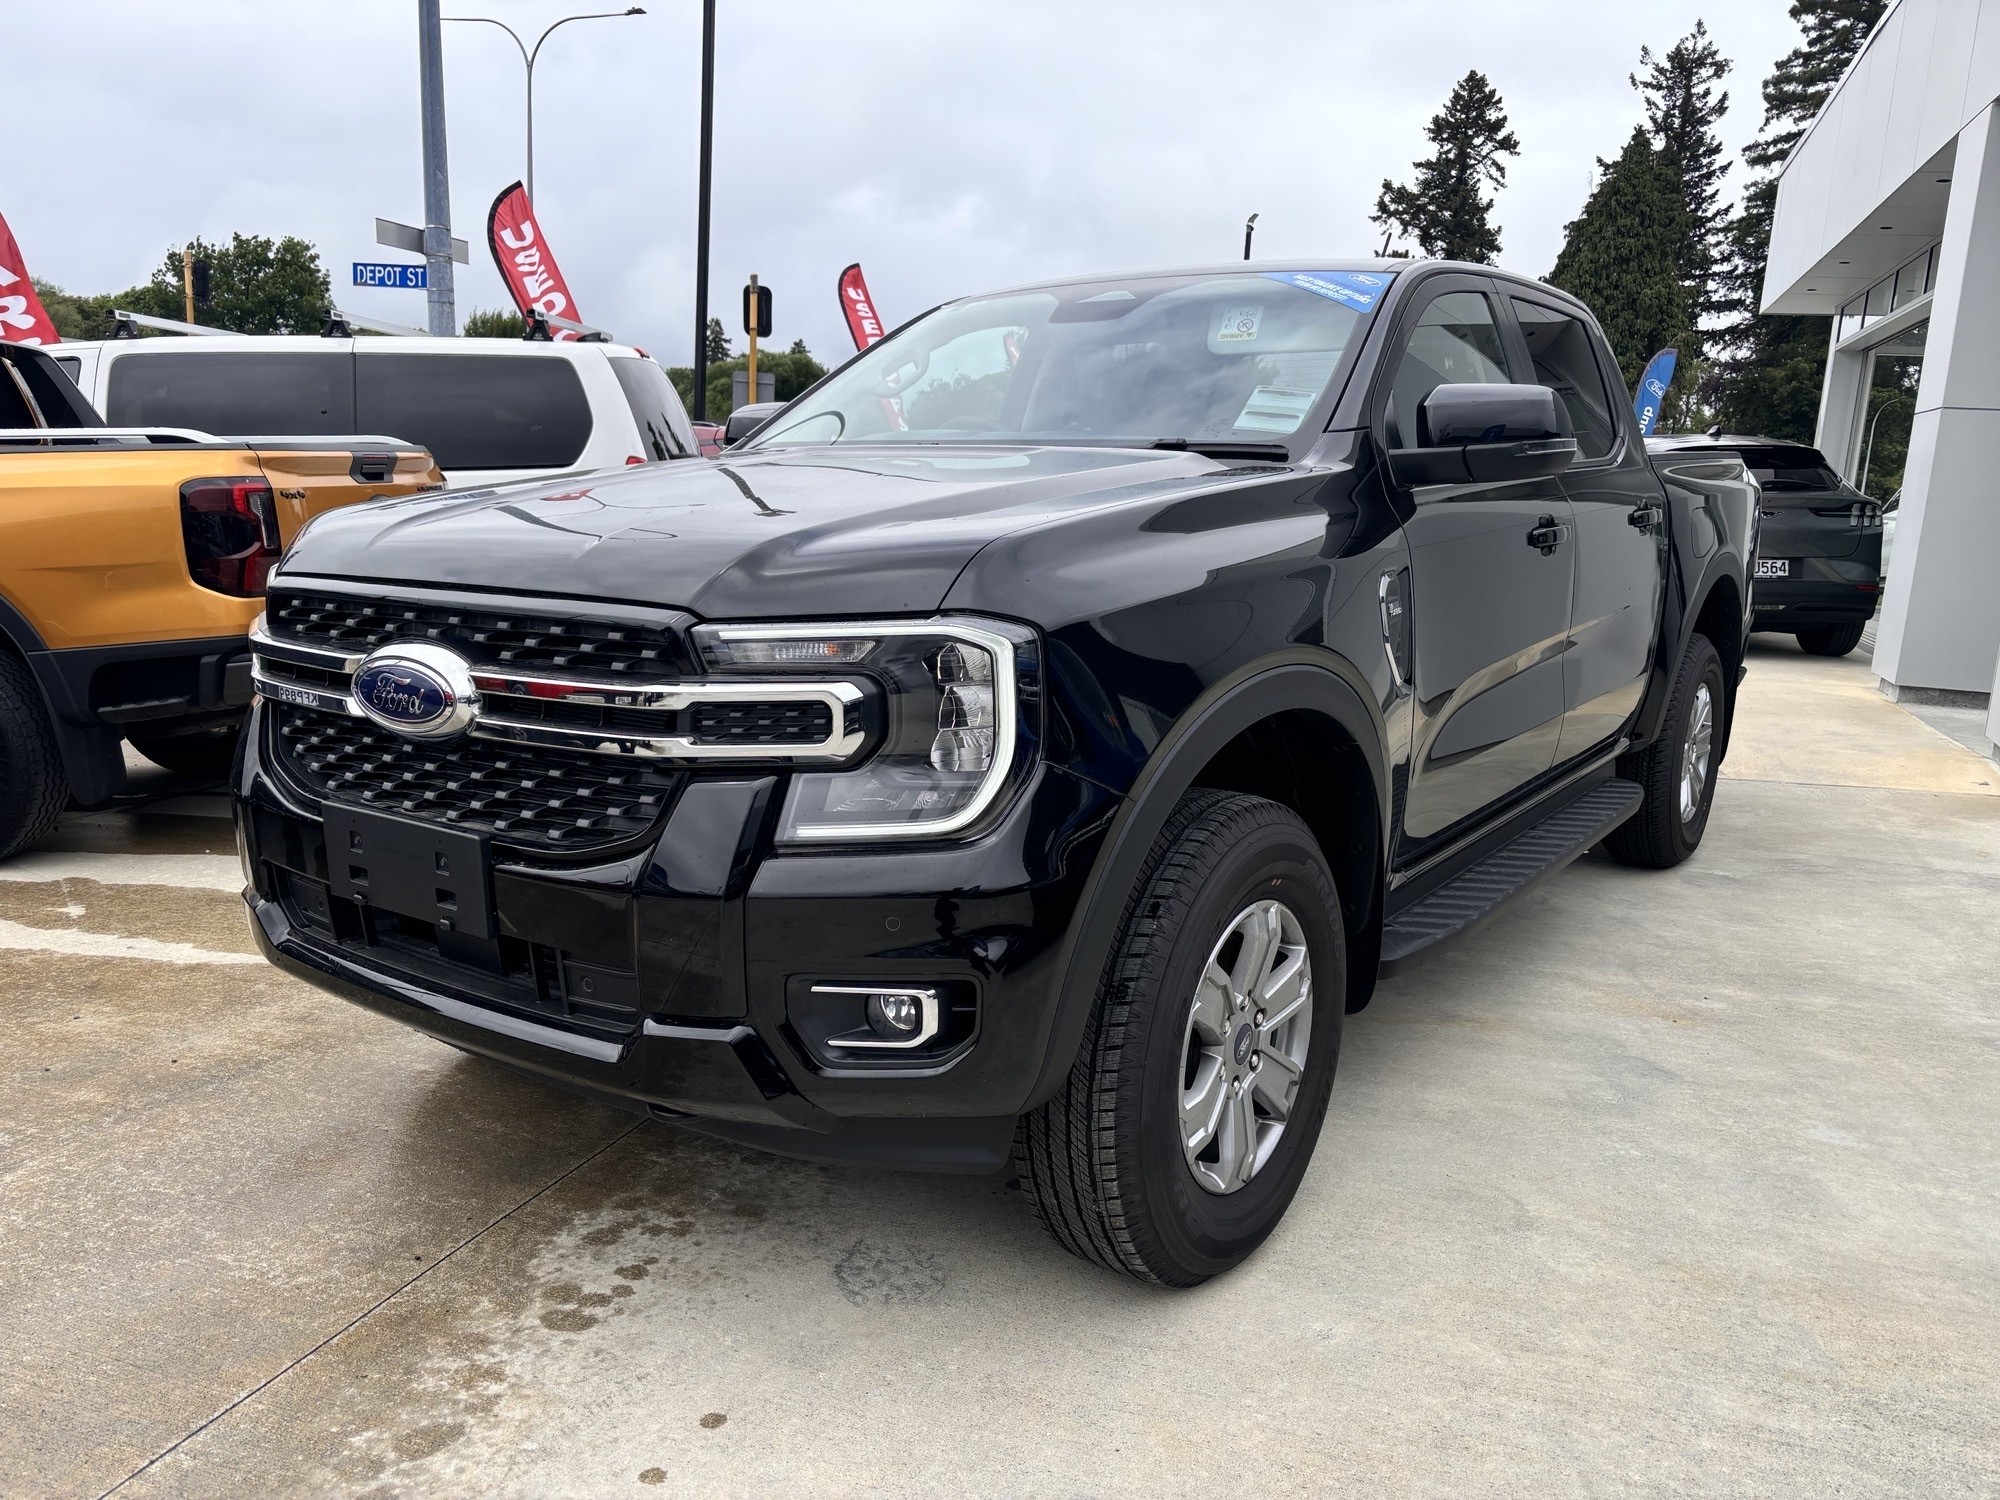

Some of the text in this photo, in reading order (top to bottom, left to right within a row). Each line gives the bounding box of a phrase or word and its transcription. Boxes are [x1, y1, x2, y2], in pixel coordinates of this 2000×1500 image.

[356, 265, 424, 287] DEPOT ST
[1640, 406, 1653, 434] oup
[372, 672, 425, 715] Ford
